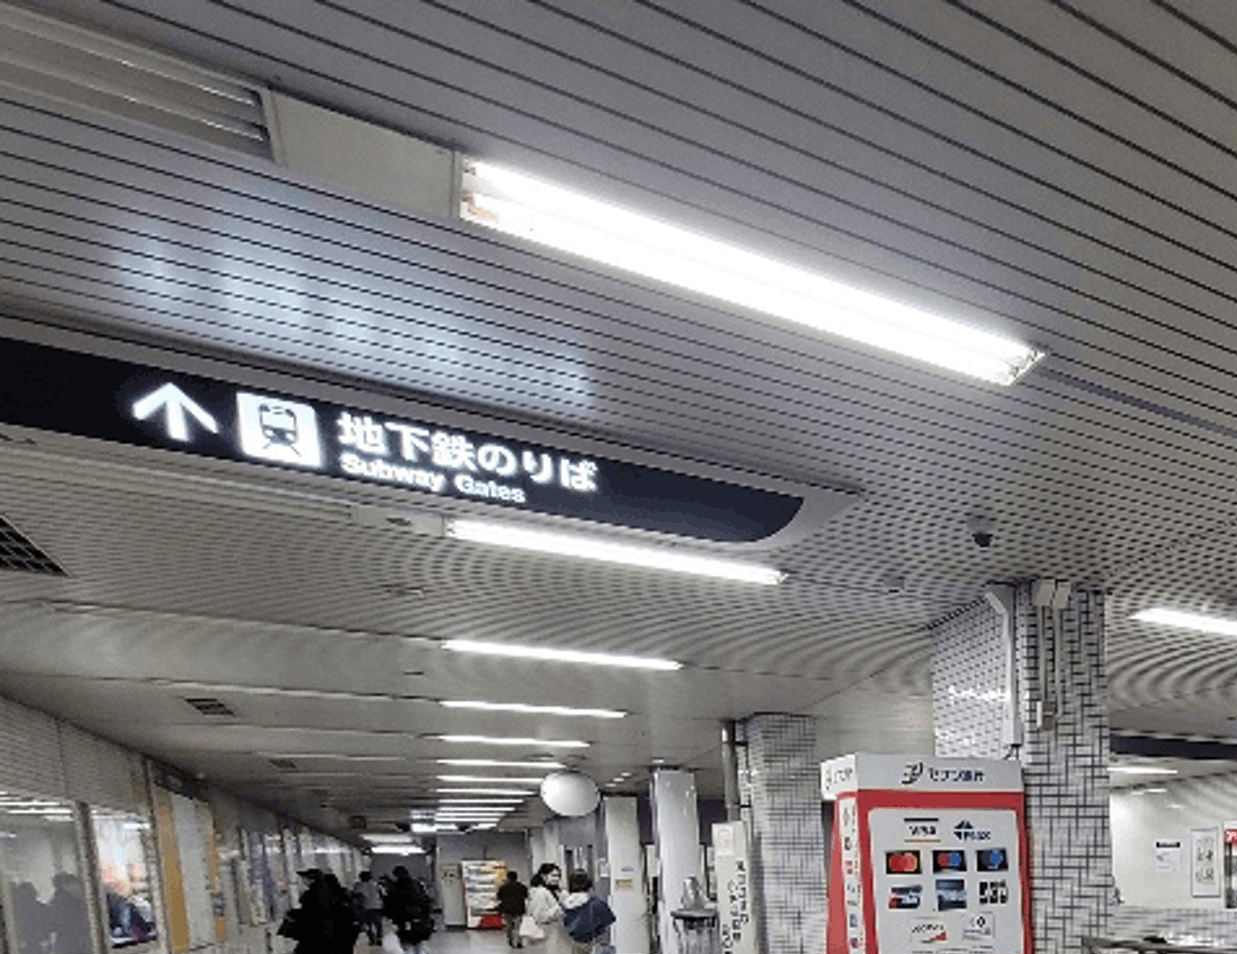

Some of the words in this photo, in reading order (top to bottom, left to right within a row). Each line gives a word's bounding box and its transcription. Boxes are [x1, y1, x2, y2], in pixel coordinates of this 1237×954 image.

[336, 411, 598, 492] 地下鉄のりば
[340, 452, 447, 493] Subway
[454, 473, 526, 503] Gates
